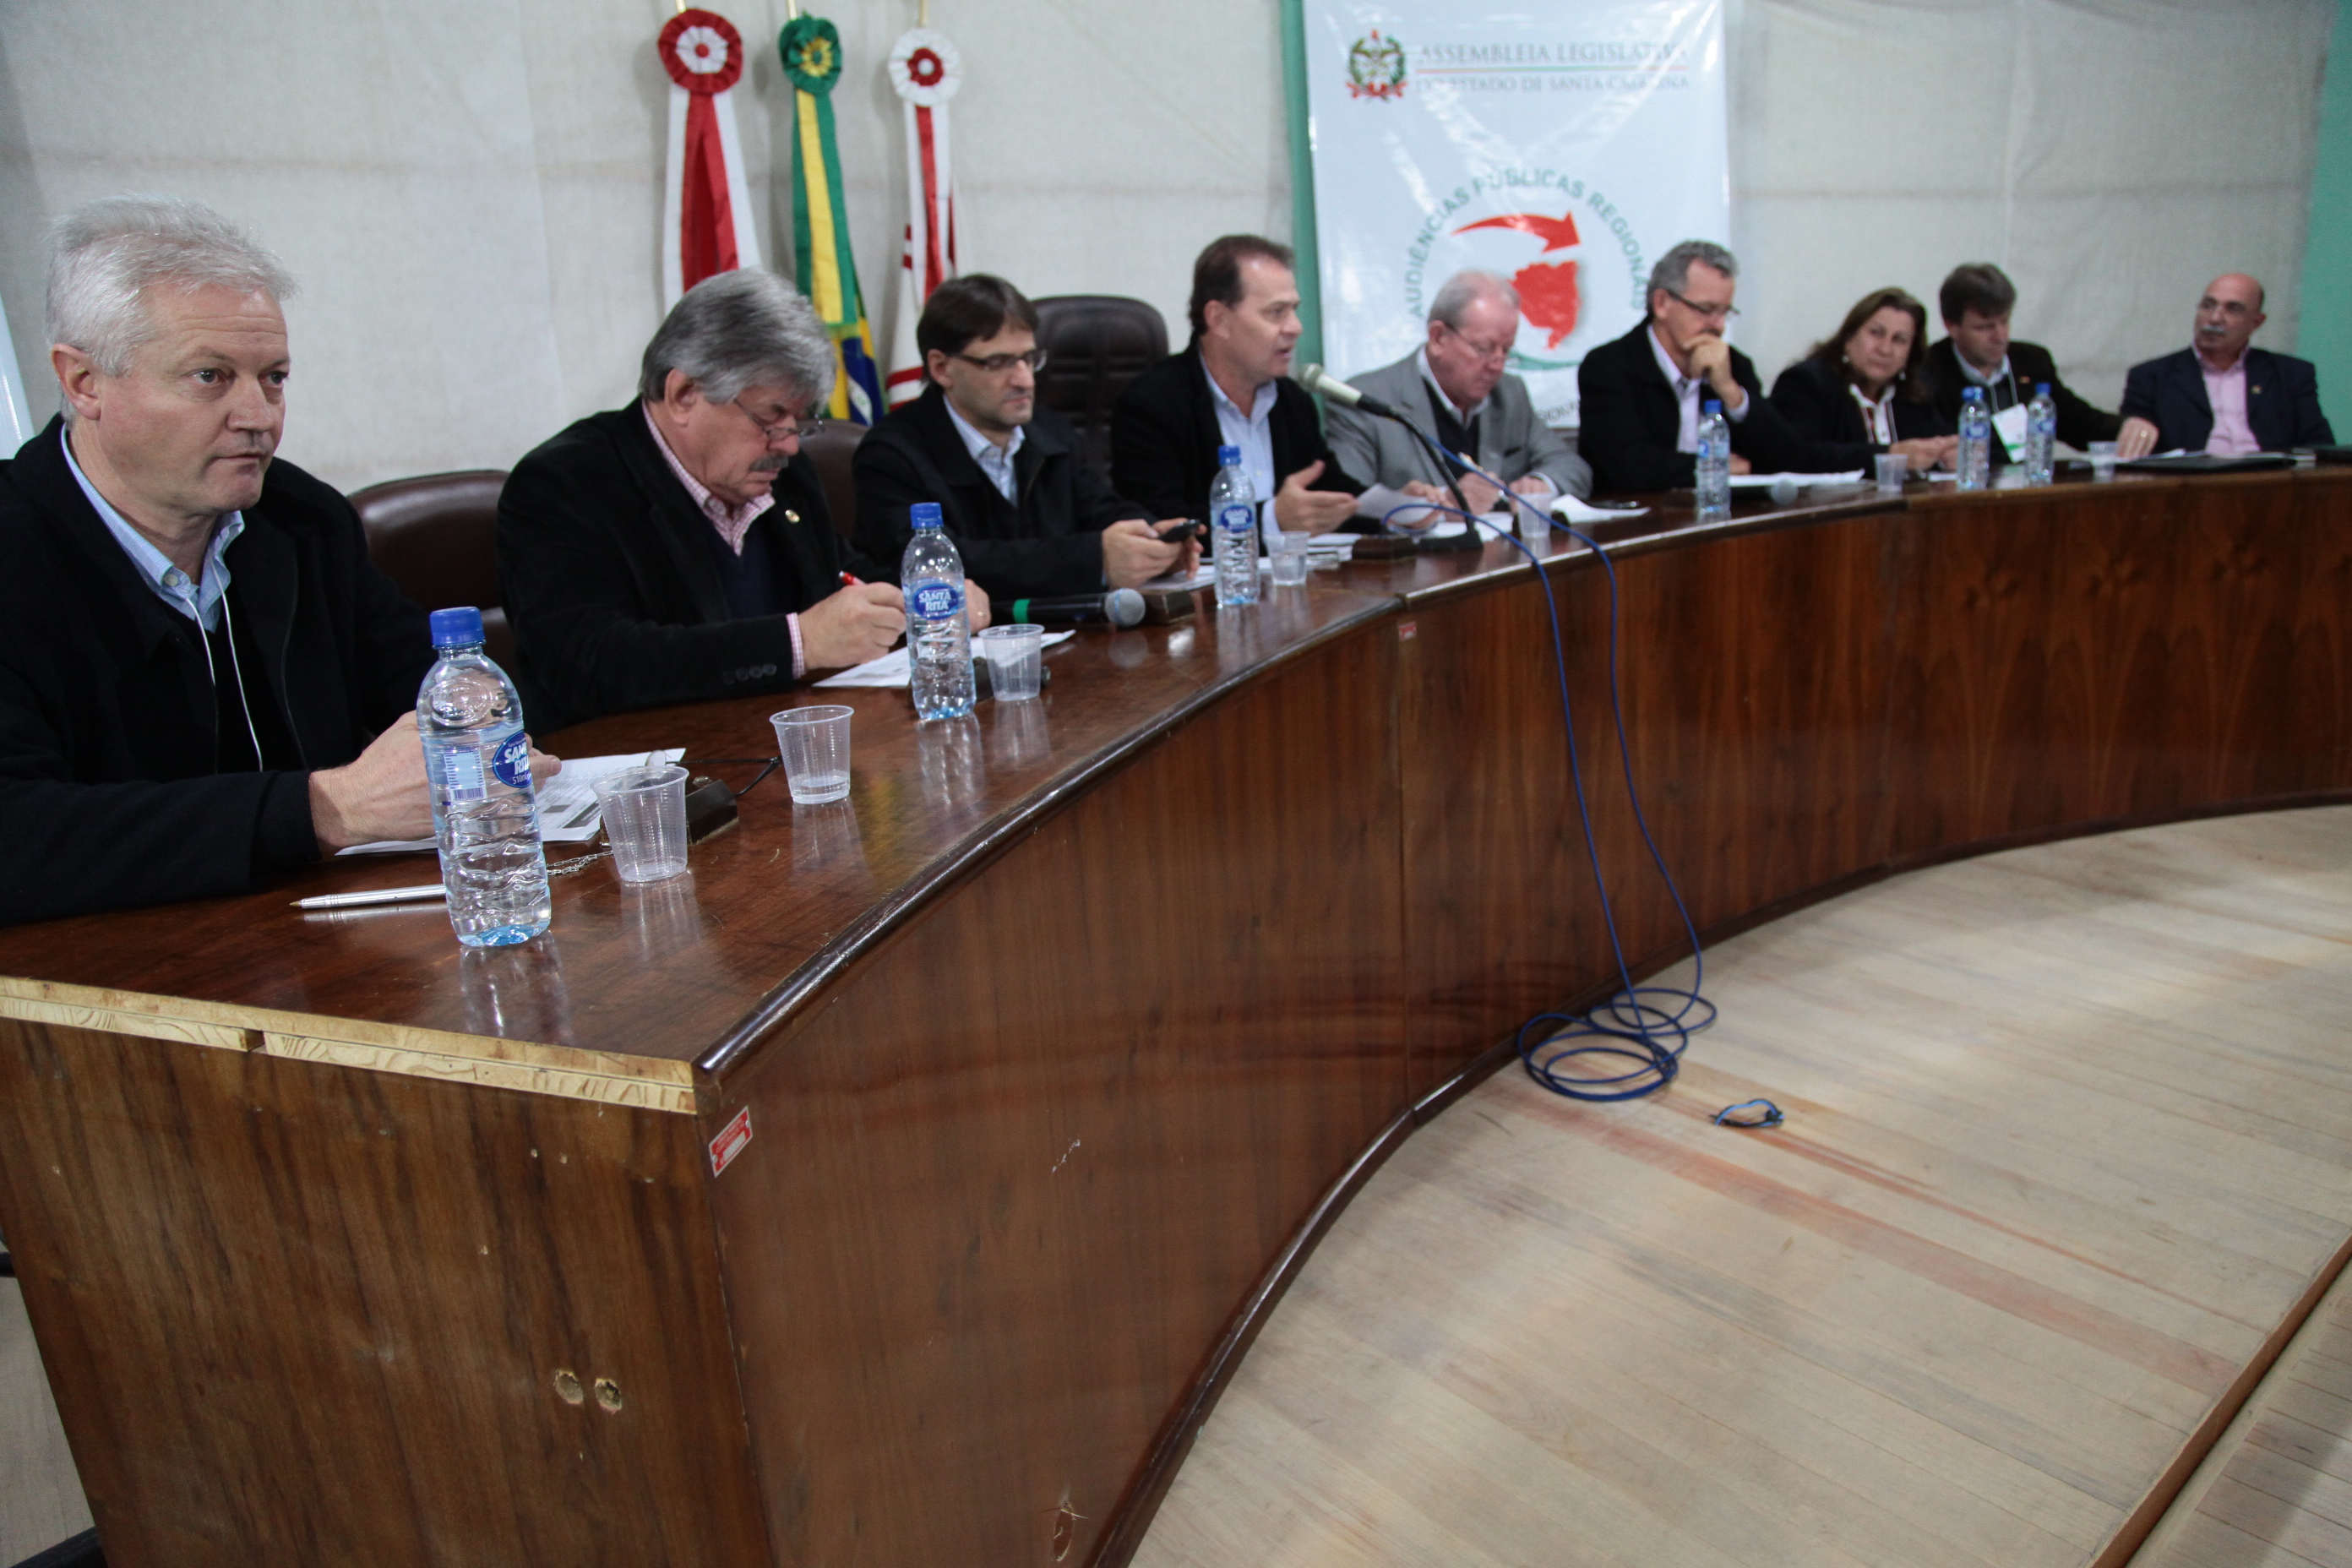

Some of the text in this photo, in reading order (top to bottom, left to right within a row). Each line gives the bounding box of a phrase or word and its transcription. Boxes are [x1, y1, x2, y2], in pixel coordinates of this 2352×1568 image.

[1606, 74, 1690, 90] CATANA
[1588, 192, 1648, 310] REGIONAIS
[918, 591, 951, 603] SANTA
[926, 601, 949, 612] RITA
